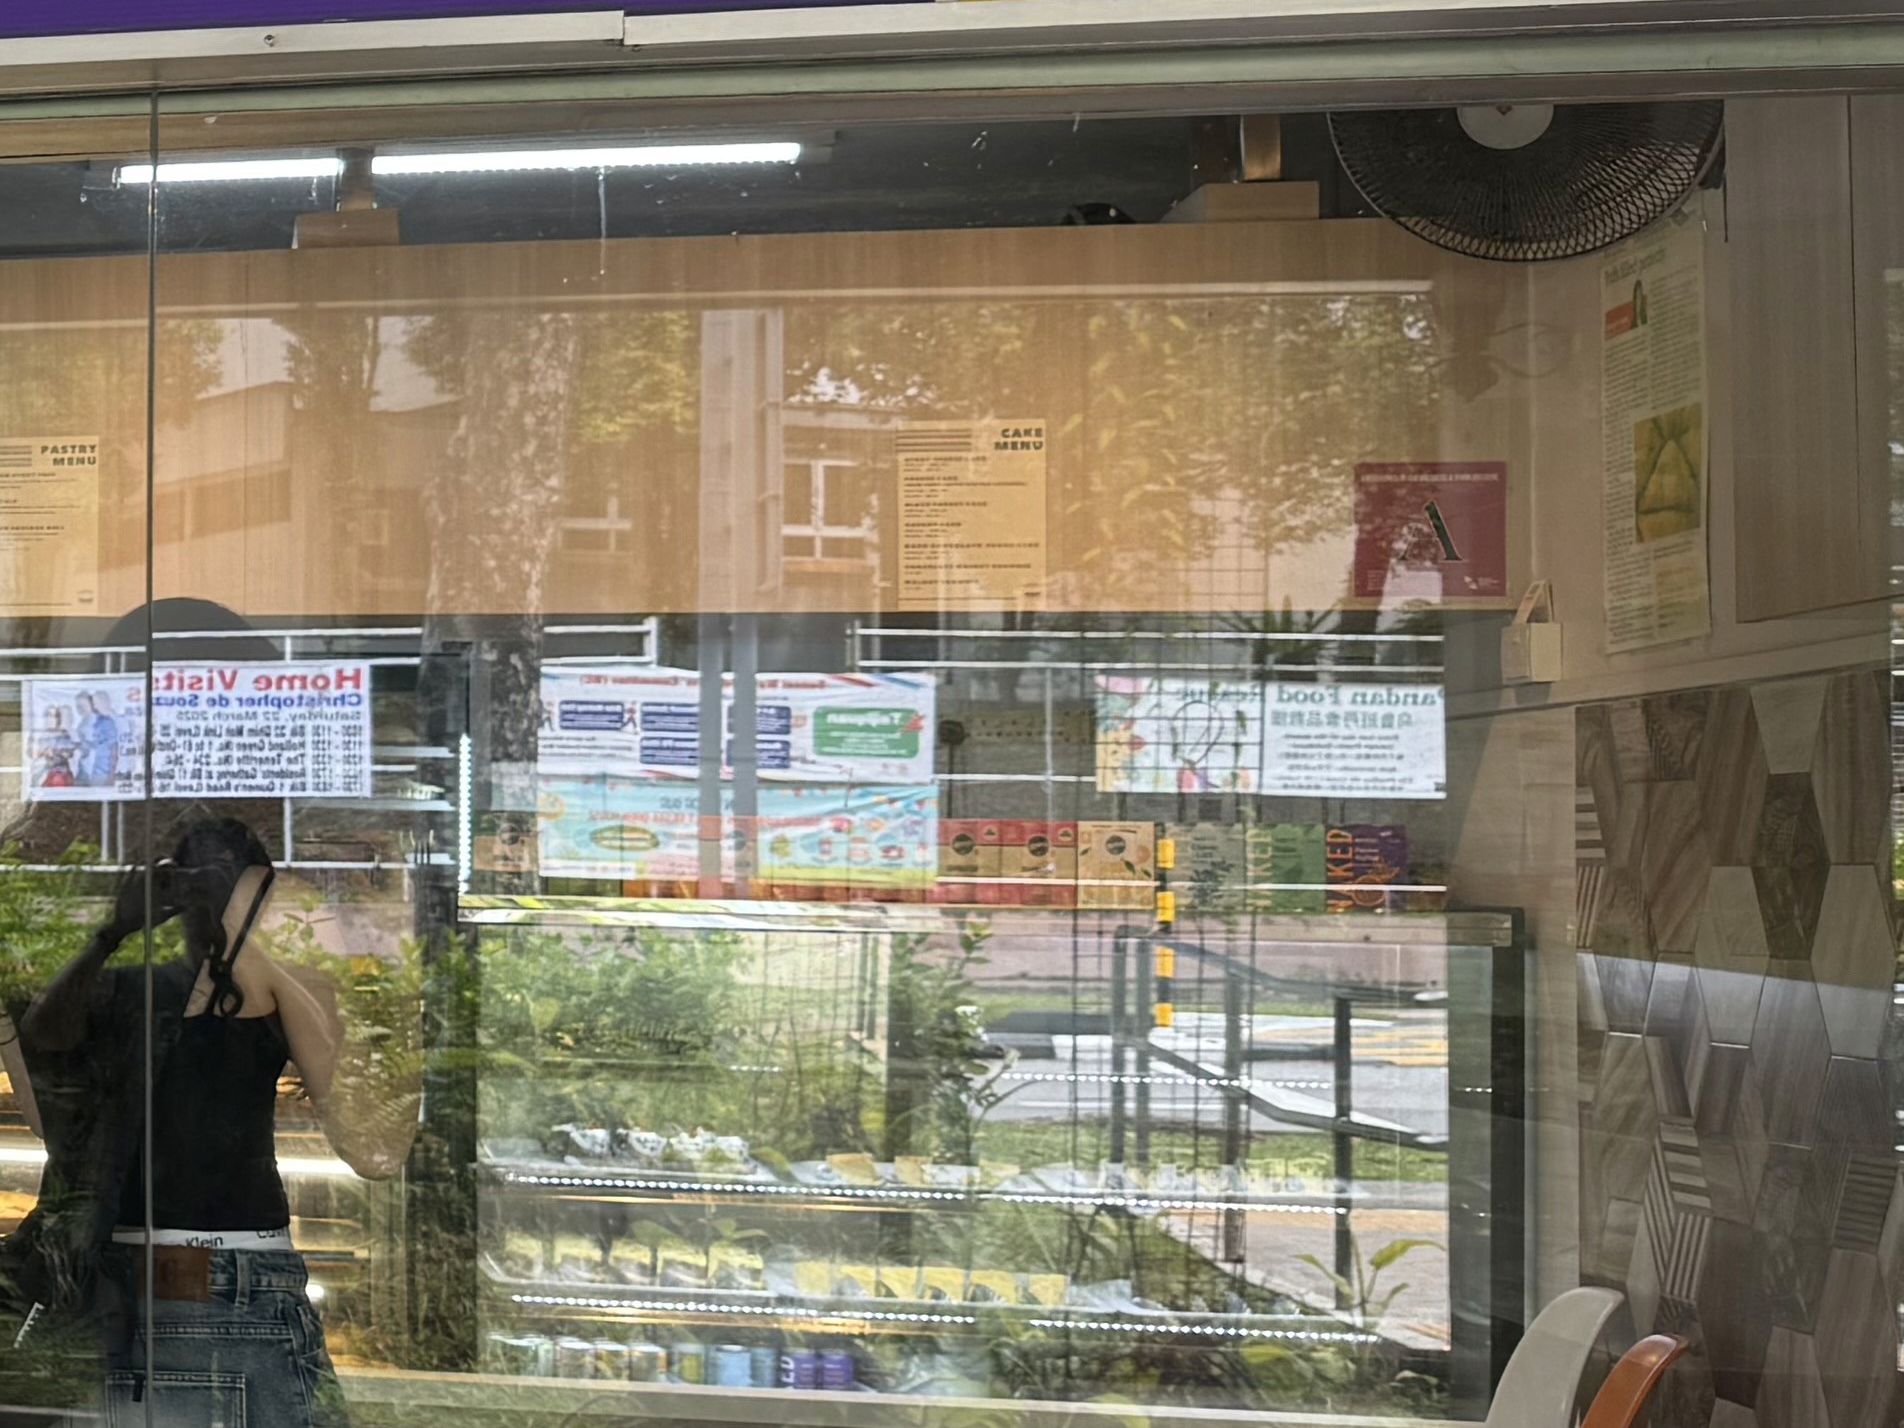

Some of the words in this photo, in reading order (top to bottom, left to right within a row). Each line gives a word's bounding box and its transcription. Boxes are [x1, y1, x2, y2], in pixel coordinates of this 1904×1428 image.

[1001, 428, 1043, 438] CAKE
[41, 444, 97, 454] PASTRY
[994, 441, 1043, 451] MENU
[52, 457, 96, 467] MENU
[185, 1236, 223, 1248] Klein
